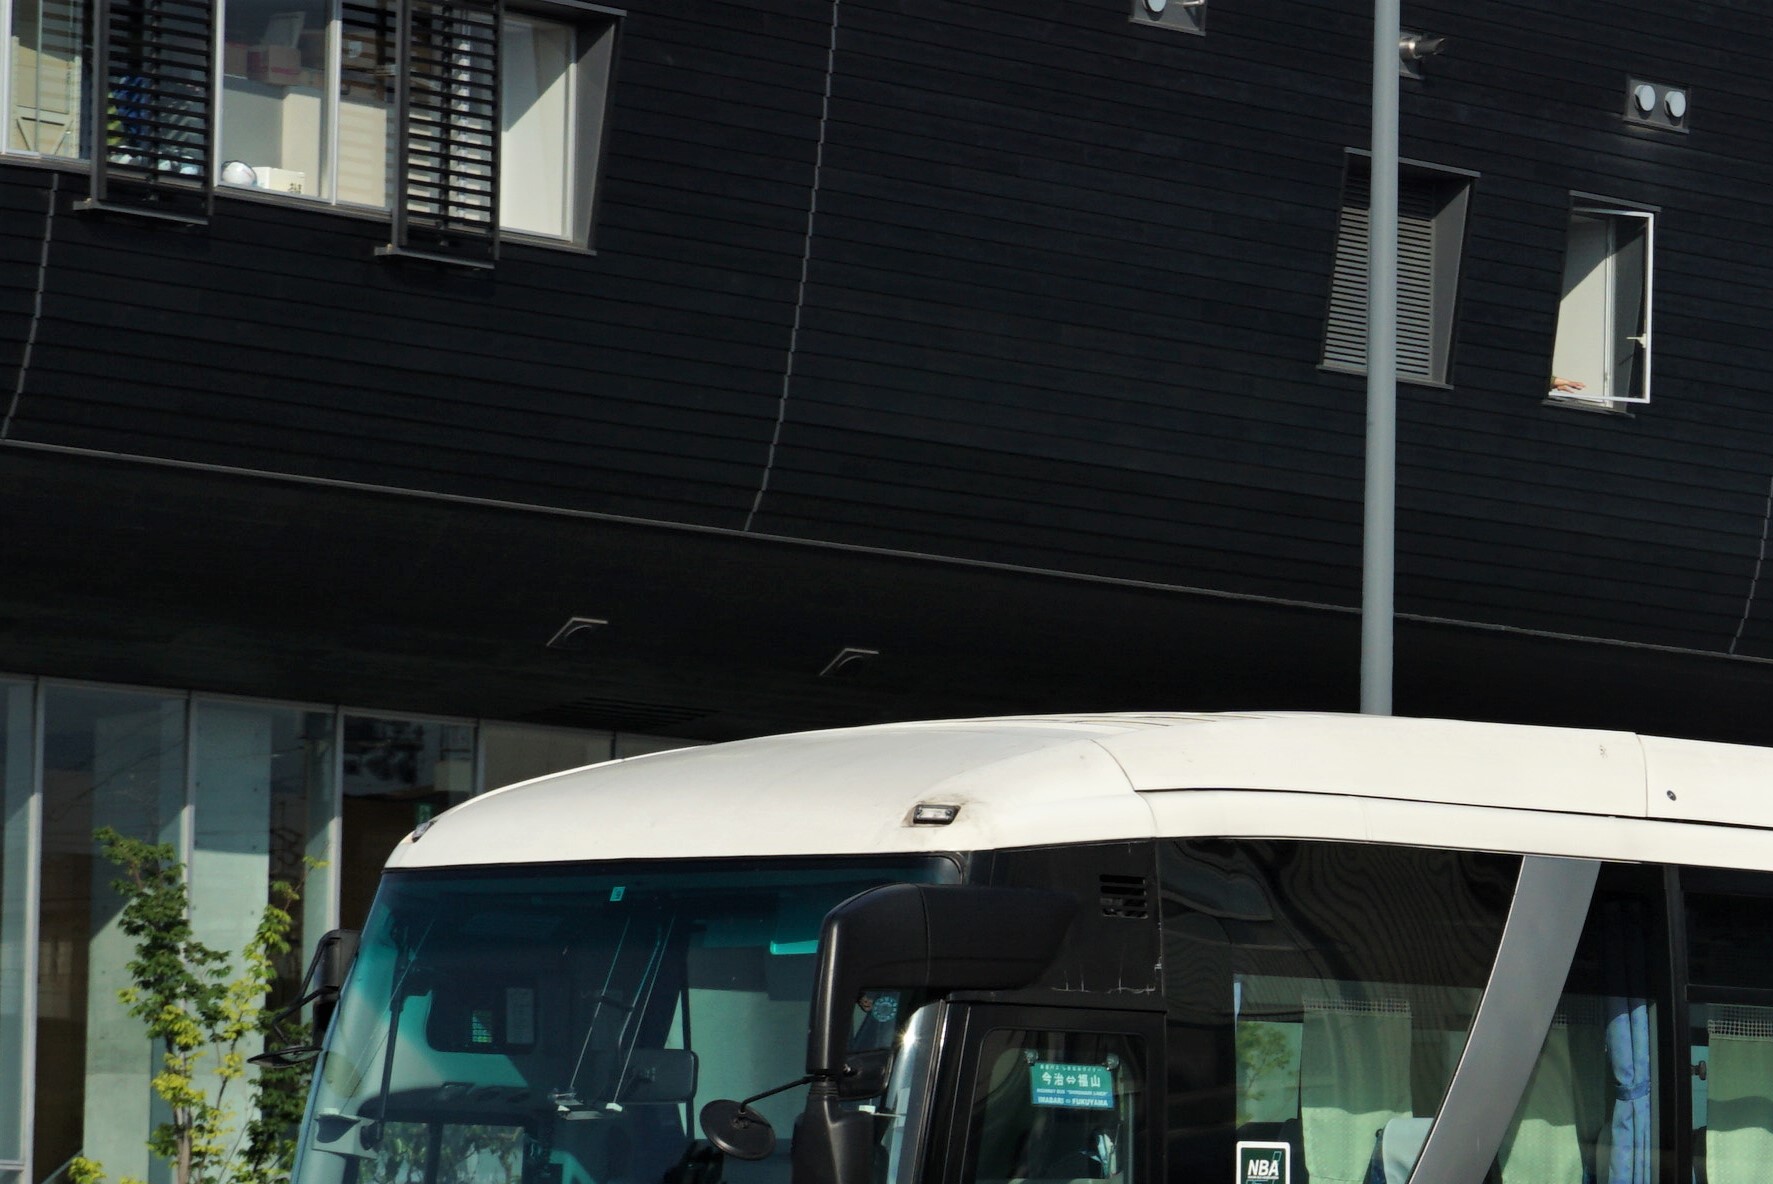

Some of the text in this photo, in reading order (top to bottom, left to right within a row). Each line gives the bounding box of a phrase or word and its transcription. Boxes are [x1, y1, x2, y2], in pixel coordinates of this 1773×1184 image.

[1041, 1071, 1101, 1088] 今治 福山
[1247, 1159, 1279, 1176] NBA
